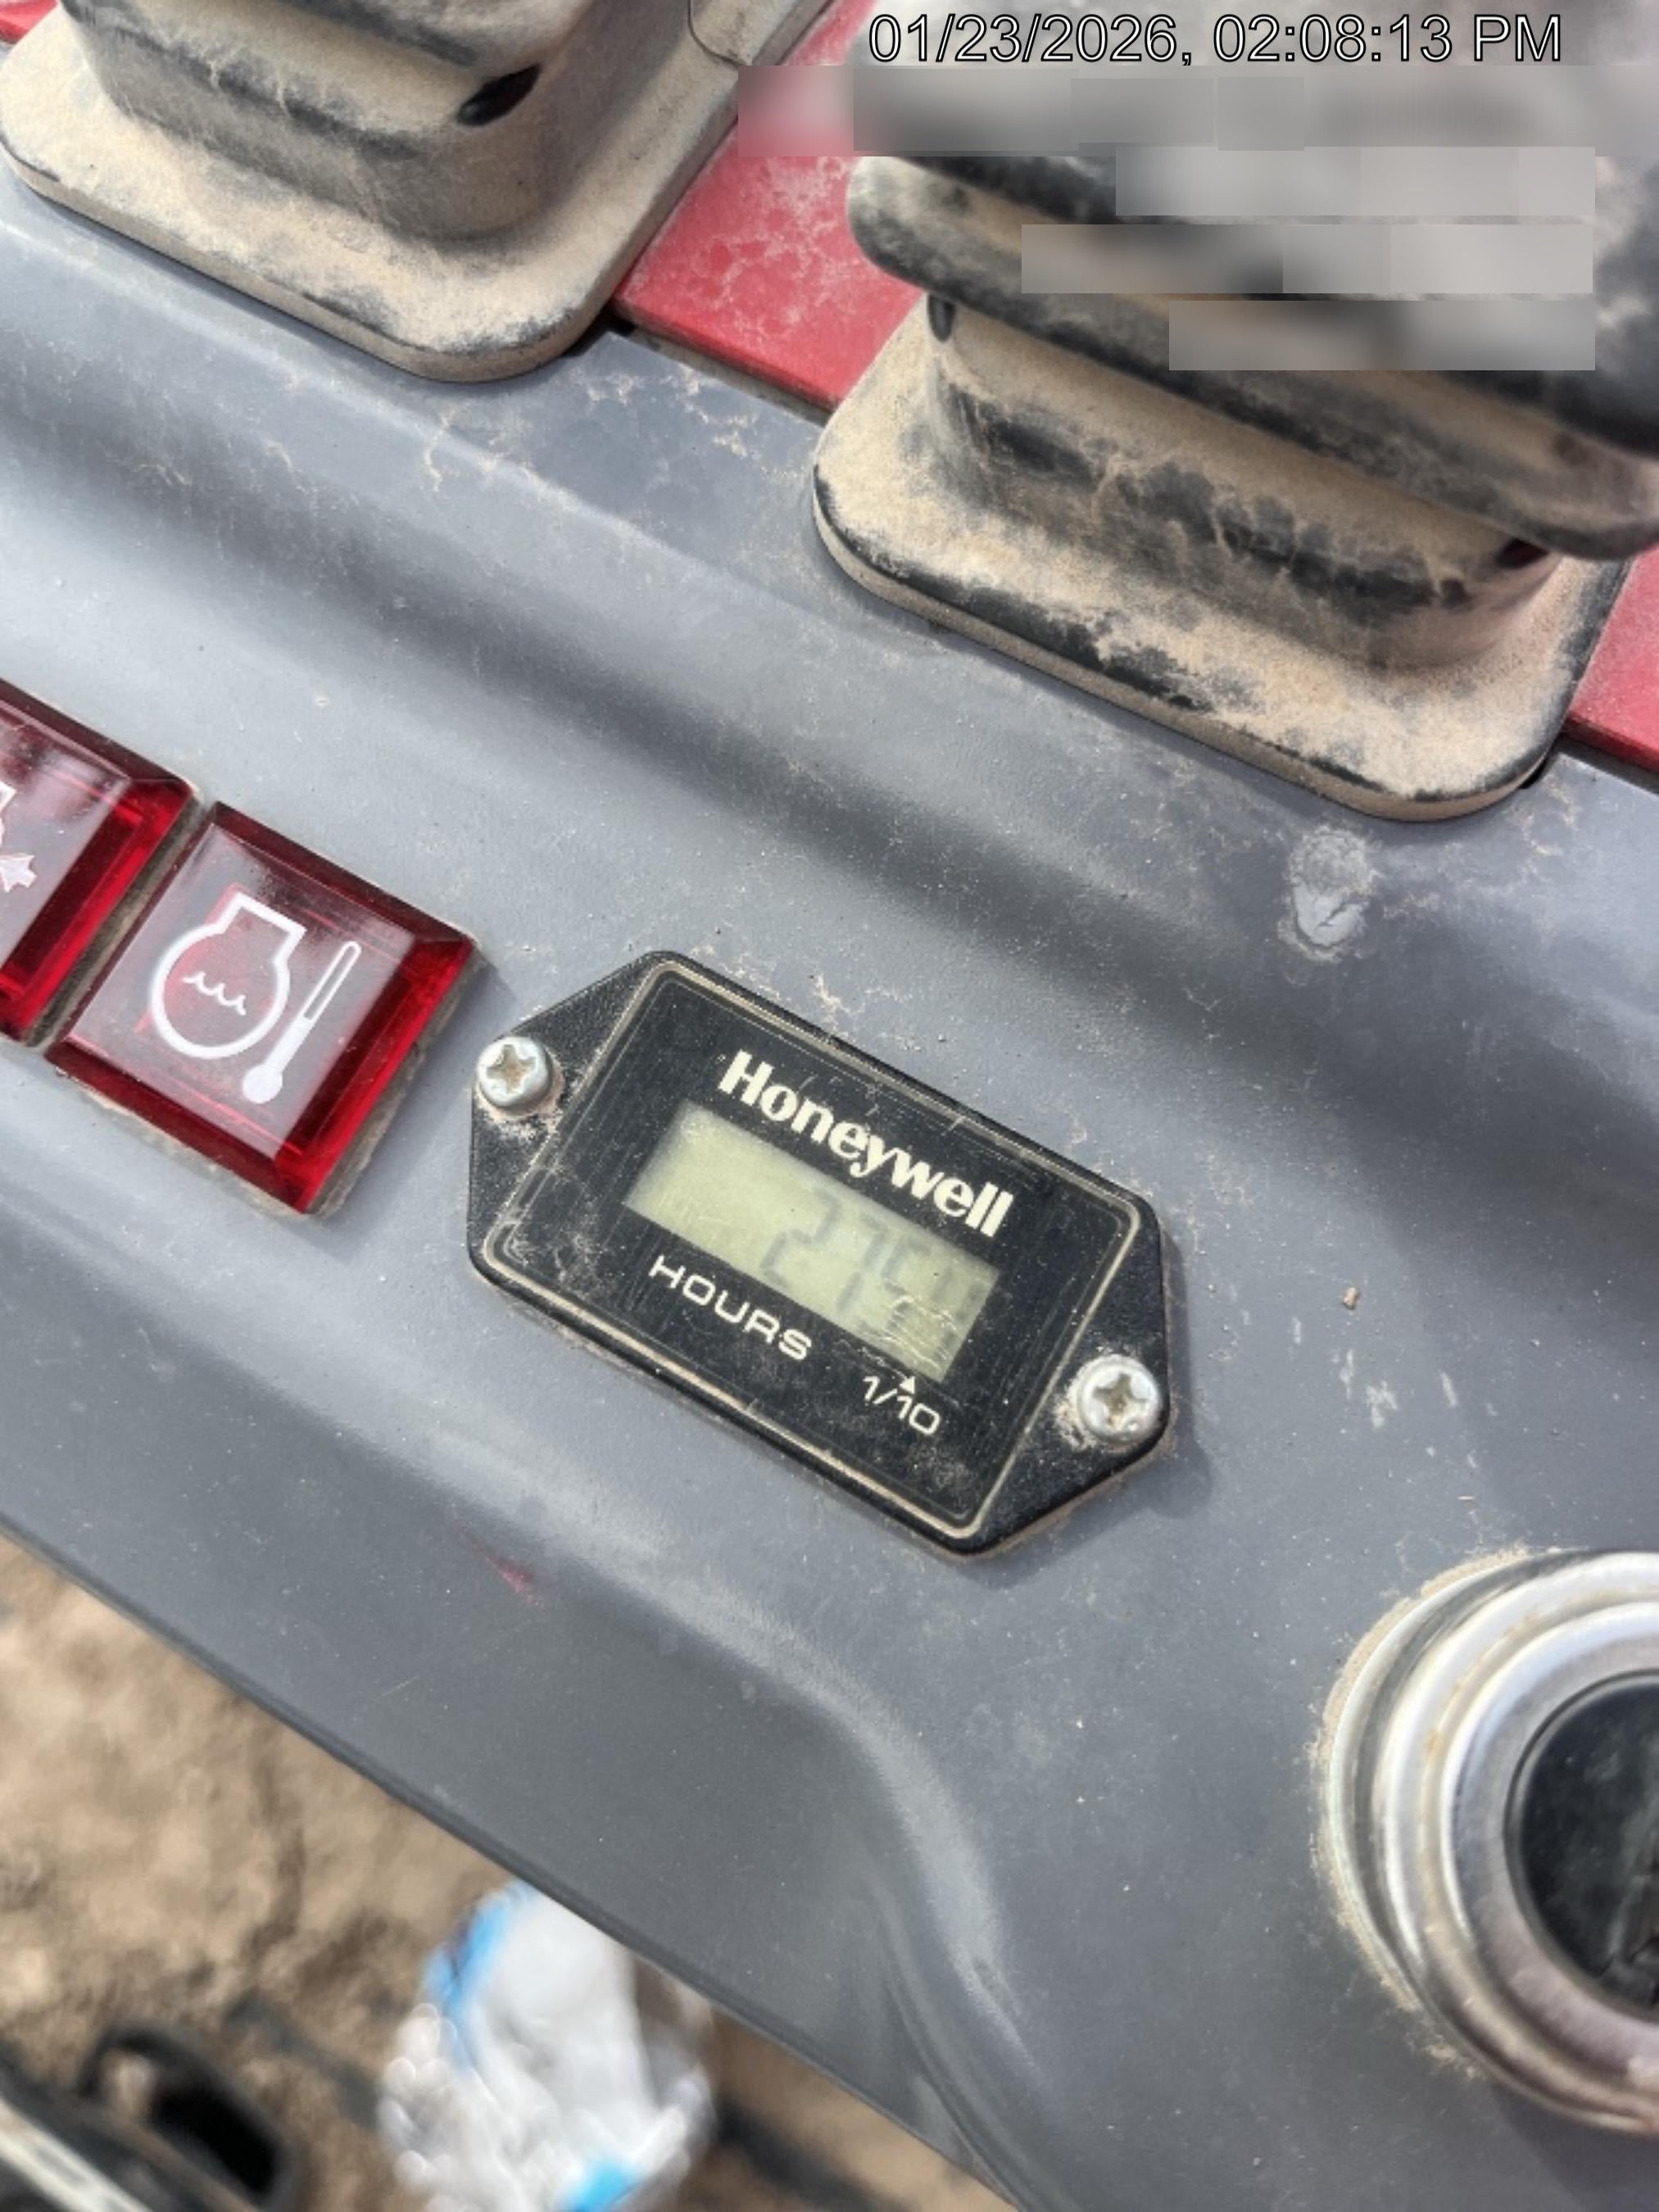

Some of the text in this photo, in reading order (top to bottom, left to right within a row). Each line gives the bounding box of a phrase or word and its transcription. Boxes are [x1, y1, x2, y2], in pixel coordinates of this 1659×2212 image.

[718, 1049, 1013, 1237] Honeywell
[648, 1254, 941, 1435] HOURS 1/10
